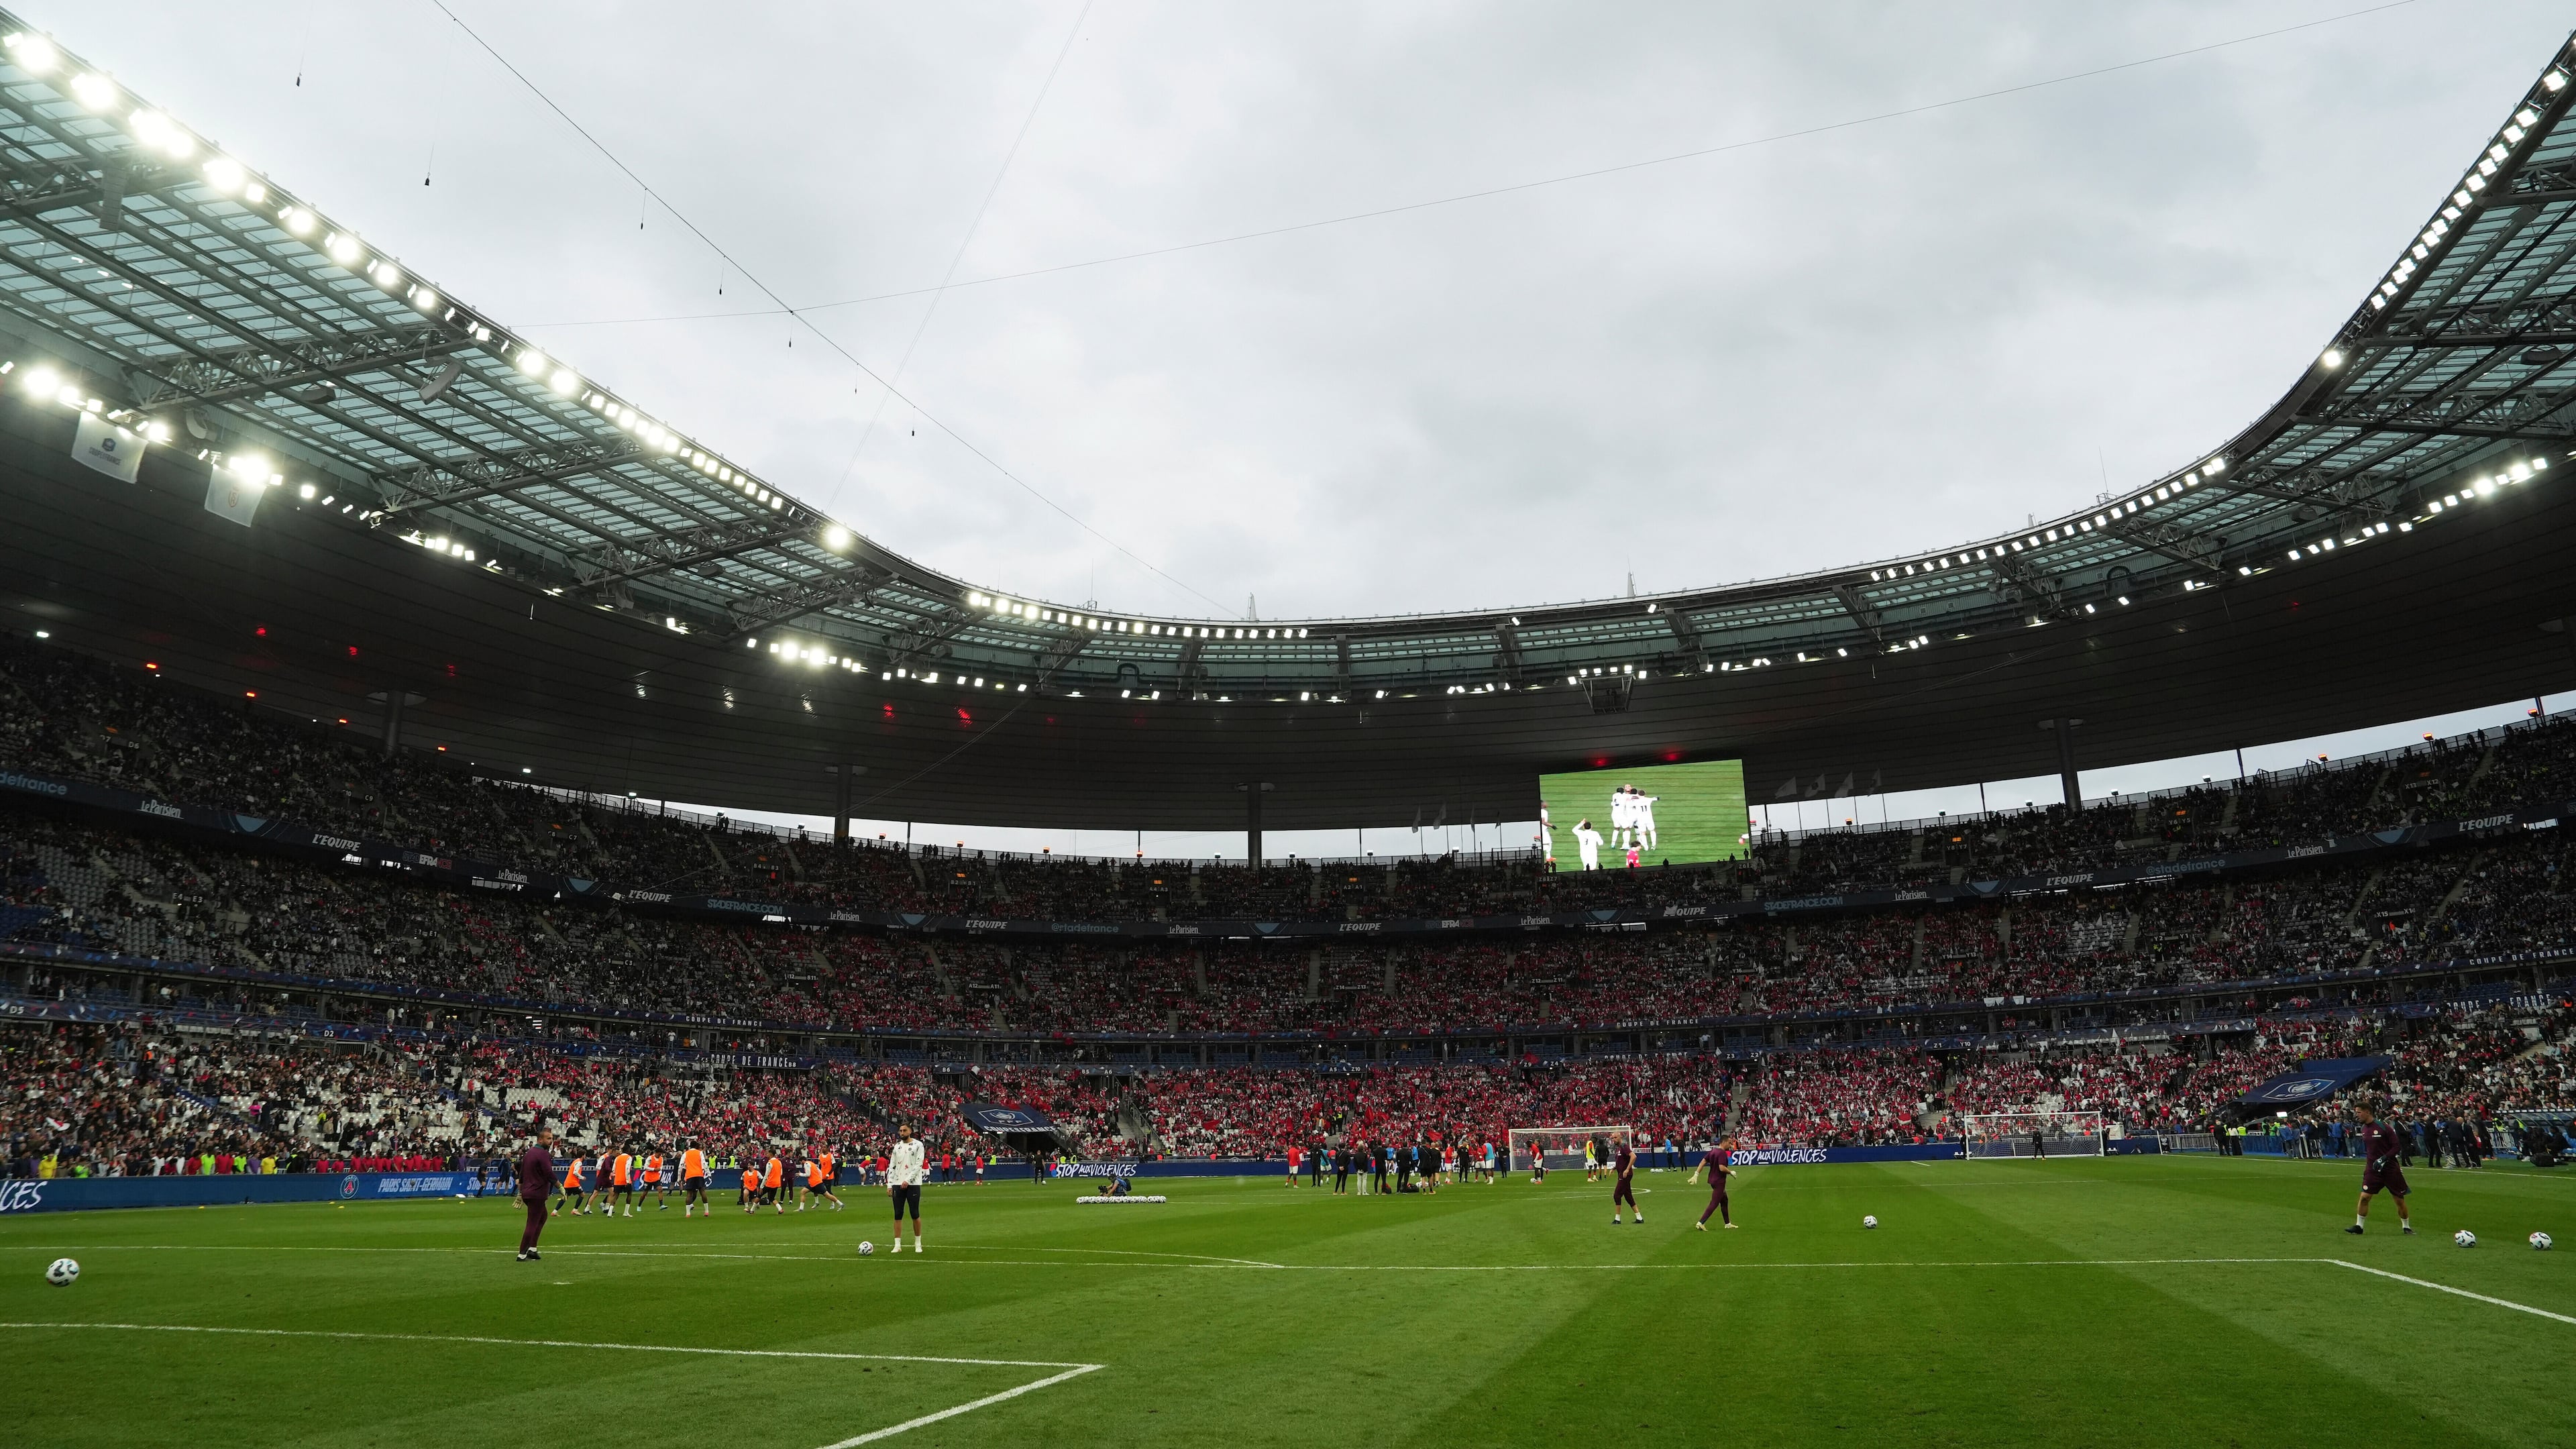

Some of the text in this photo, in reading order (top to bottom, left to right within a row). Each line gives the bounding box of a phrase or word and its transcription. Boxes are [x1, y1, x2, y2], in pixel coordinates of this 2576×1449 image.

[364, 794, 374, 802] C9
[142, 800, 182, 818] Le Parisien
[2288, 845, 2324, 858] Le Parisien
[2146, 859, 2226, 876] @stadefrance
[498, 869, 528, 883] Le Parisien
[1901, 890, 1927, 900] Parisien
[830, 910, 859, 922] Le Parisien
[1527, 916, 1550, 925] Parisien
[1169, 924, 1199, 934] Le Parisien
[2469, 948, 2574, 965] COUPE DE FRANCE
[9, 1006, 25, 1014] D5
[686, 1016, 712, 1024] COUPE
[733, 1019, 763, 1027] FRANCE
[323, 1029, 334, 1037] D2
[742, 1055, 751, 1066] DE
[757, 1056, 788, 1068] FRANCE
[1731, 1148, 1827, 1166] STOP AUX VIOLENCES
[1056, 1163, 1137, 1177] STOP AUX VIOLENCES
[377, 1177, 454, 1193] PARIS SAINT-GERMAIN
